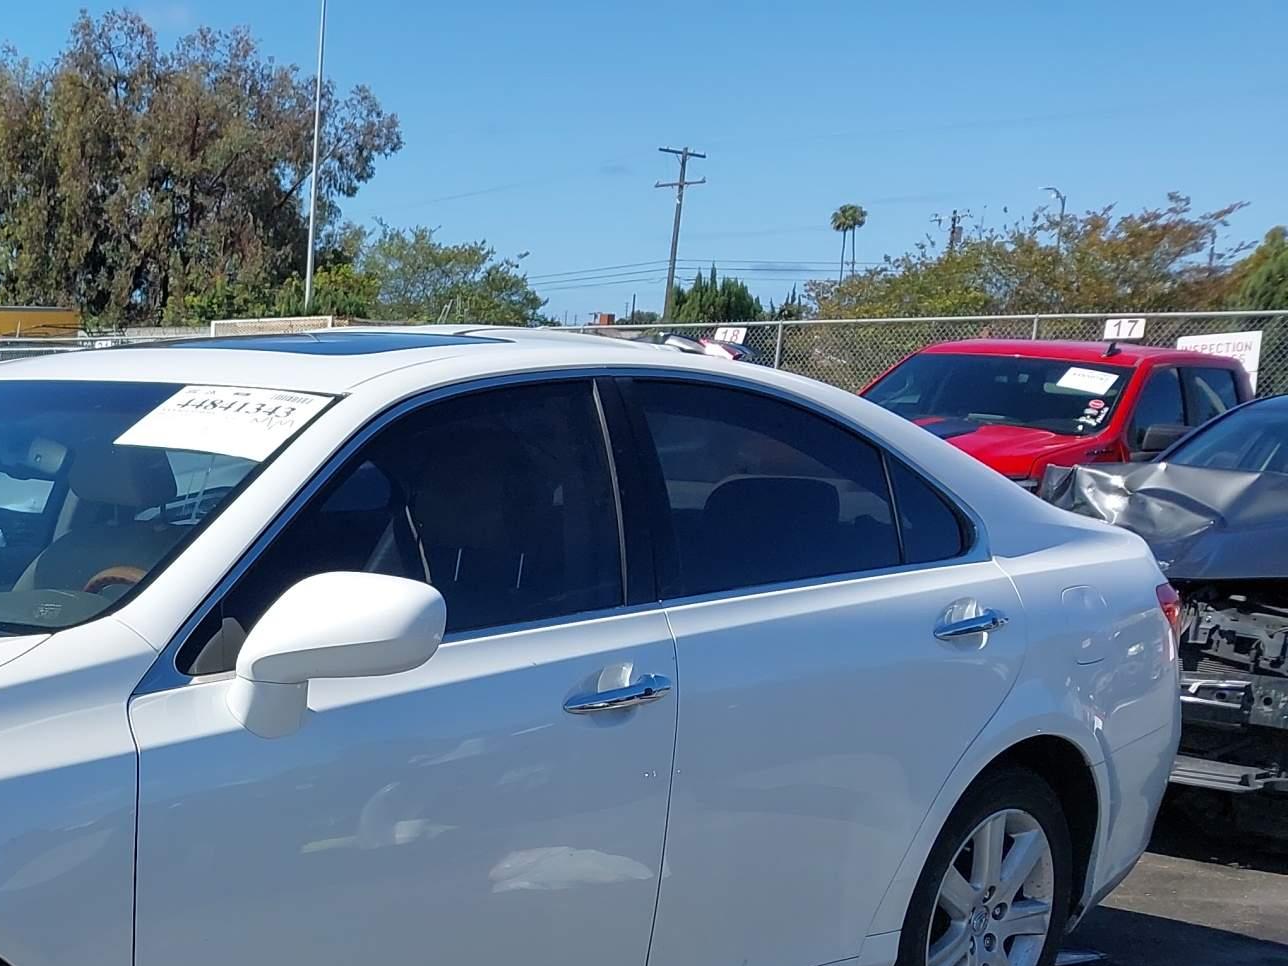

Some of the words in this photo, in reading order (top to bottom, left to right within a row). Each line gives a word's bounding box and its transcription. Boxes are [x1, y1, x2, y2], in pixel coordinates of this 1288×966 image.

[722, 329, 740, 342] 18
[1113, 320, 1139, 337] 17
[1181, 341, 1253, 353] INSPECTION
[176, 398, 297, 418] 44841343
